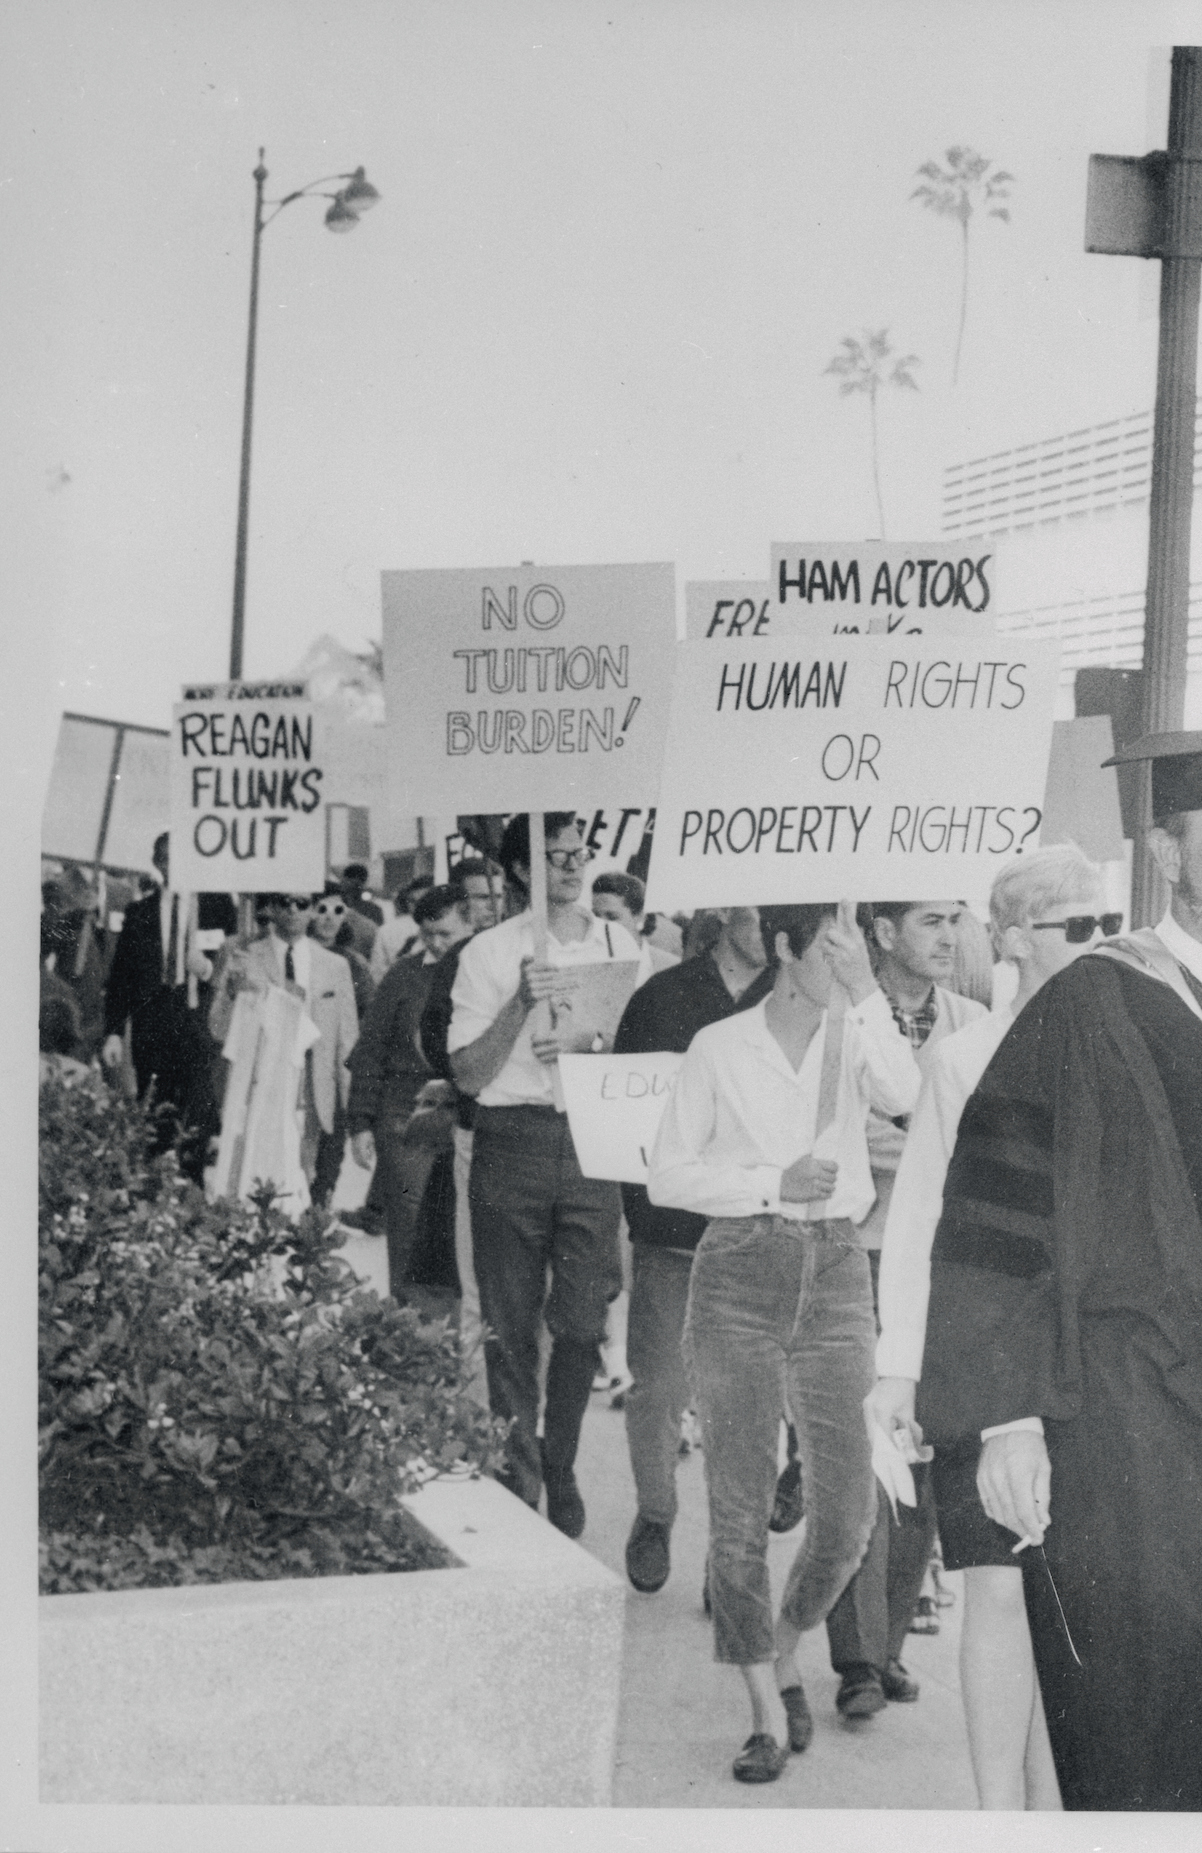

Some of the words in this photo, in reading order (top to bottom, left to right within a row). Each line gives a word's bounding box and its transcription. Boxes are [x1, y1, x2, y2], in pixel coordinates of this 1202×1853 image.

[481, 582, 566, 632] NO
[778, 557, 862, 605] HAM
[870, 553, 994, 614] ACTORS
[452, 644, 630, 695] TUITION
[716, 660, 848, 712] HUMAN
[883, 660, 1028, 710] RIGHTS
[178, 710, 313, 763] REAGAN
[446, 696, 642, 756] BURDEN!
[821, 732, 882, 782] OR
[192, 766, 324, 814] FLUNKS
[193, 813, 289, 861] OUT
[679, 805, 872, 857] PROPERTY
[887, 804, 1043, 855] RIGHTS?
